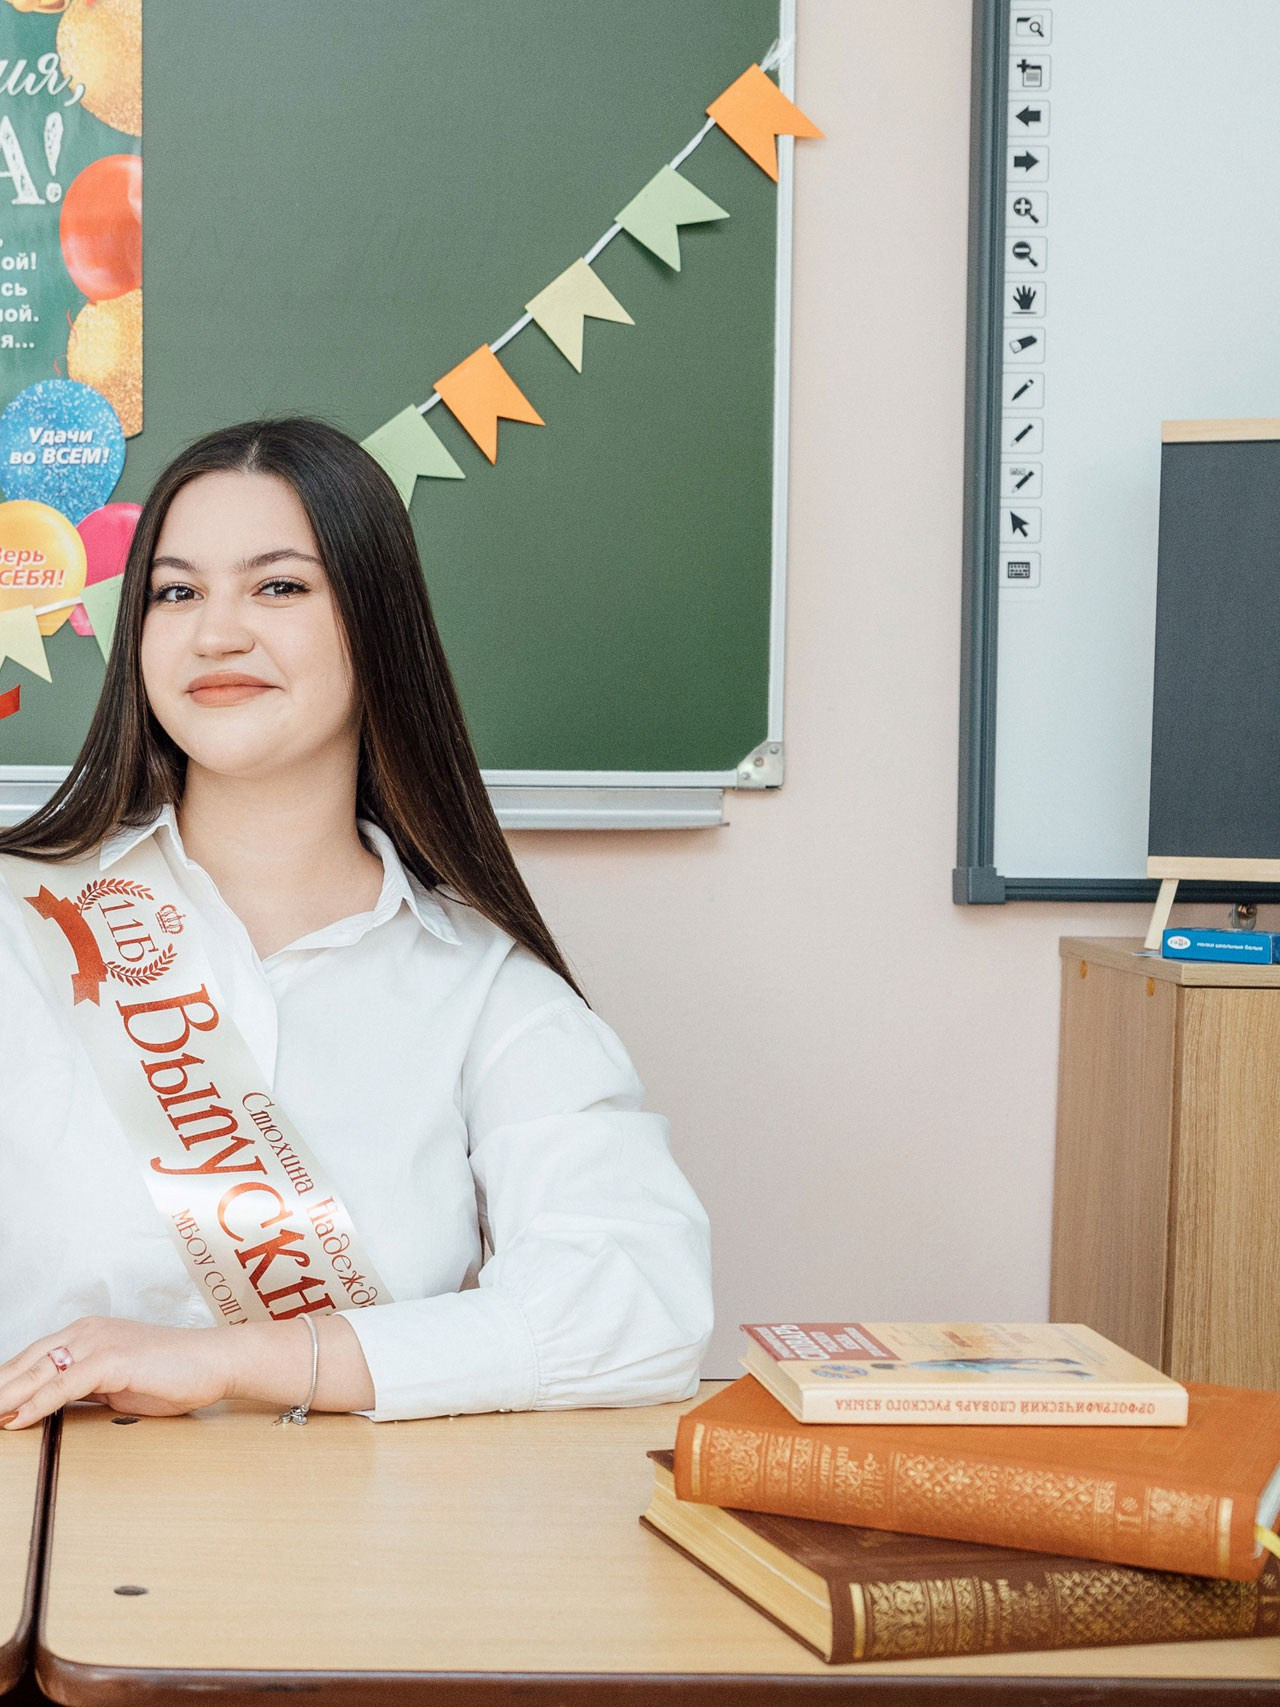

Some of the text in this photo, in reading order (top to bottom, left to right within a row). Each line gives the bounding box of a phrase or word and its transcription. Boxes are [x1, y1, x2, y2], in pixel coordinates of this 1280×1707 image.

[9, 447, 110, 466] во ВСЕМ!
[28, 426, 94, 447] Удачи
[97, 898, 160, 964] 11Б
[116, 983, 338, 1321] Выпускн
[242, 1091, 315, 1197] Стюхина
[204, 1271, 243, 1317] СОШ
[834, 1399, 1156, 1414] ОРФОГРАФИЧЕСКИЙ СЛОВАРЬ РУССКОГО ЯЗЫКА
